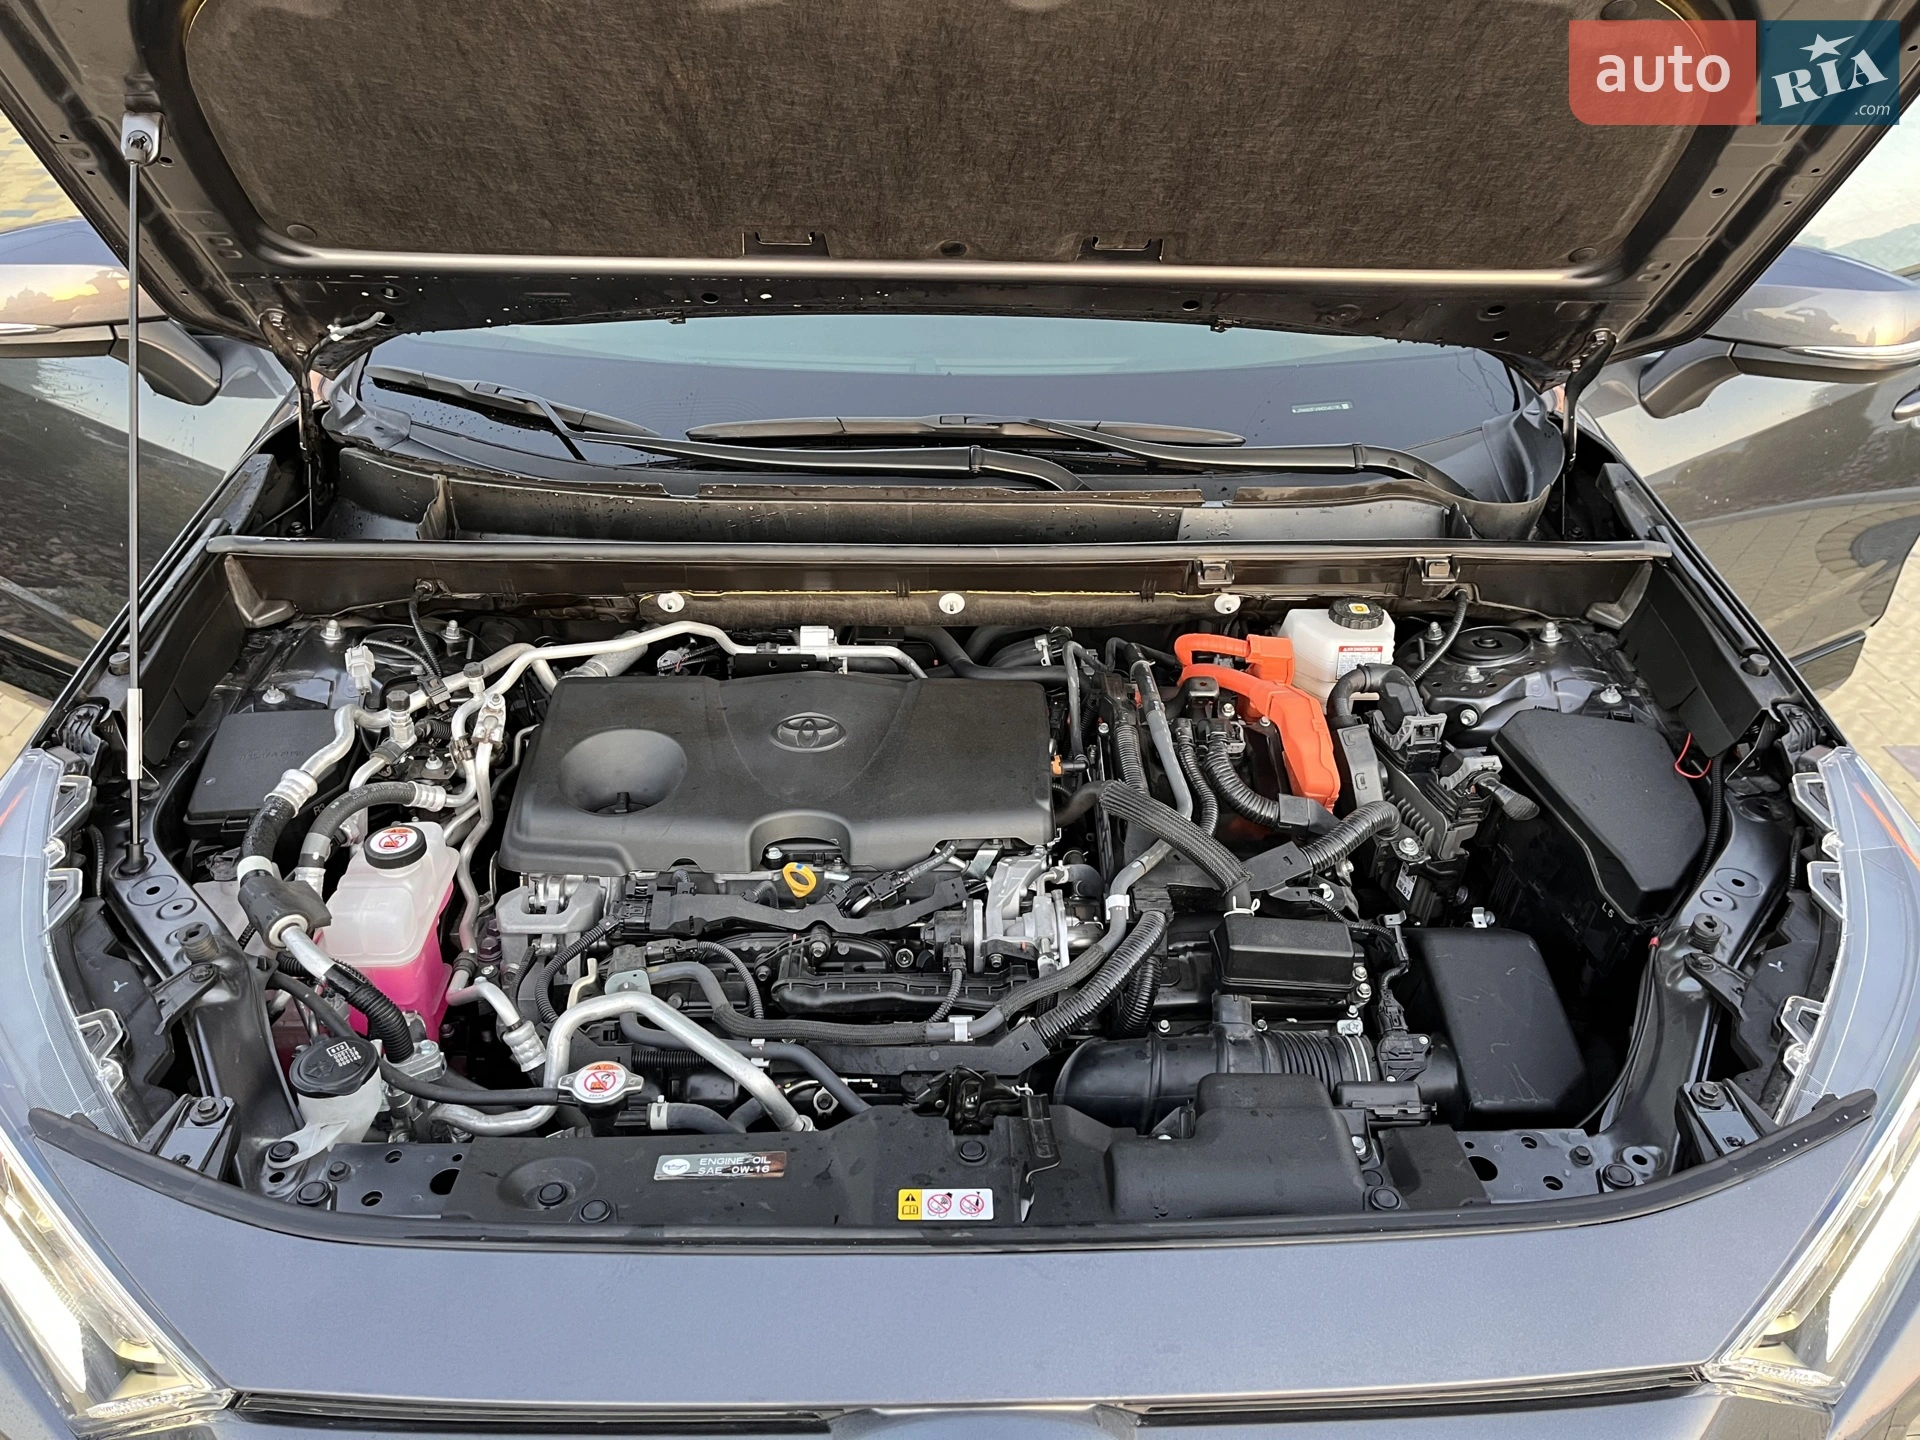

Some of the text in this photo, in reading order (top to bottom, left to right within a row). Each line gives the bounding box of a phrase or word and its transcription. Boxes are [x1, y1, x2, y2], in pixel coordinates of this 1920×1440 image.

[700, 1156, 771, 1166] ENGINE OIL
[698, 1165, 770, 1175] SAE 0W-16
